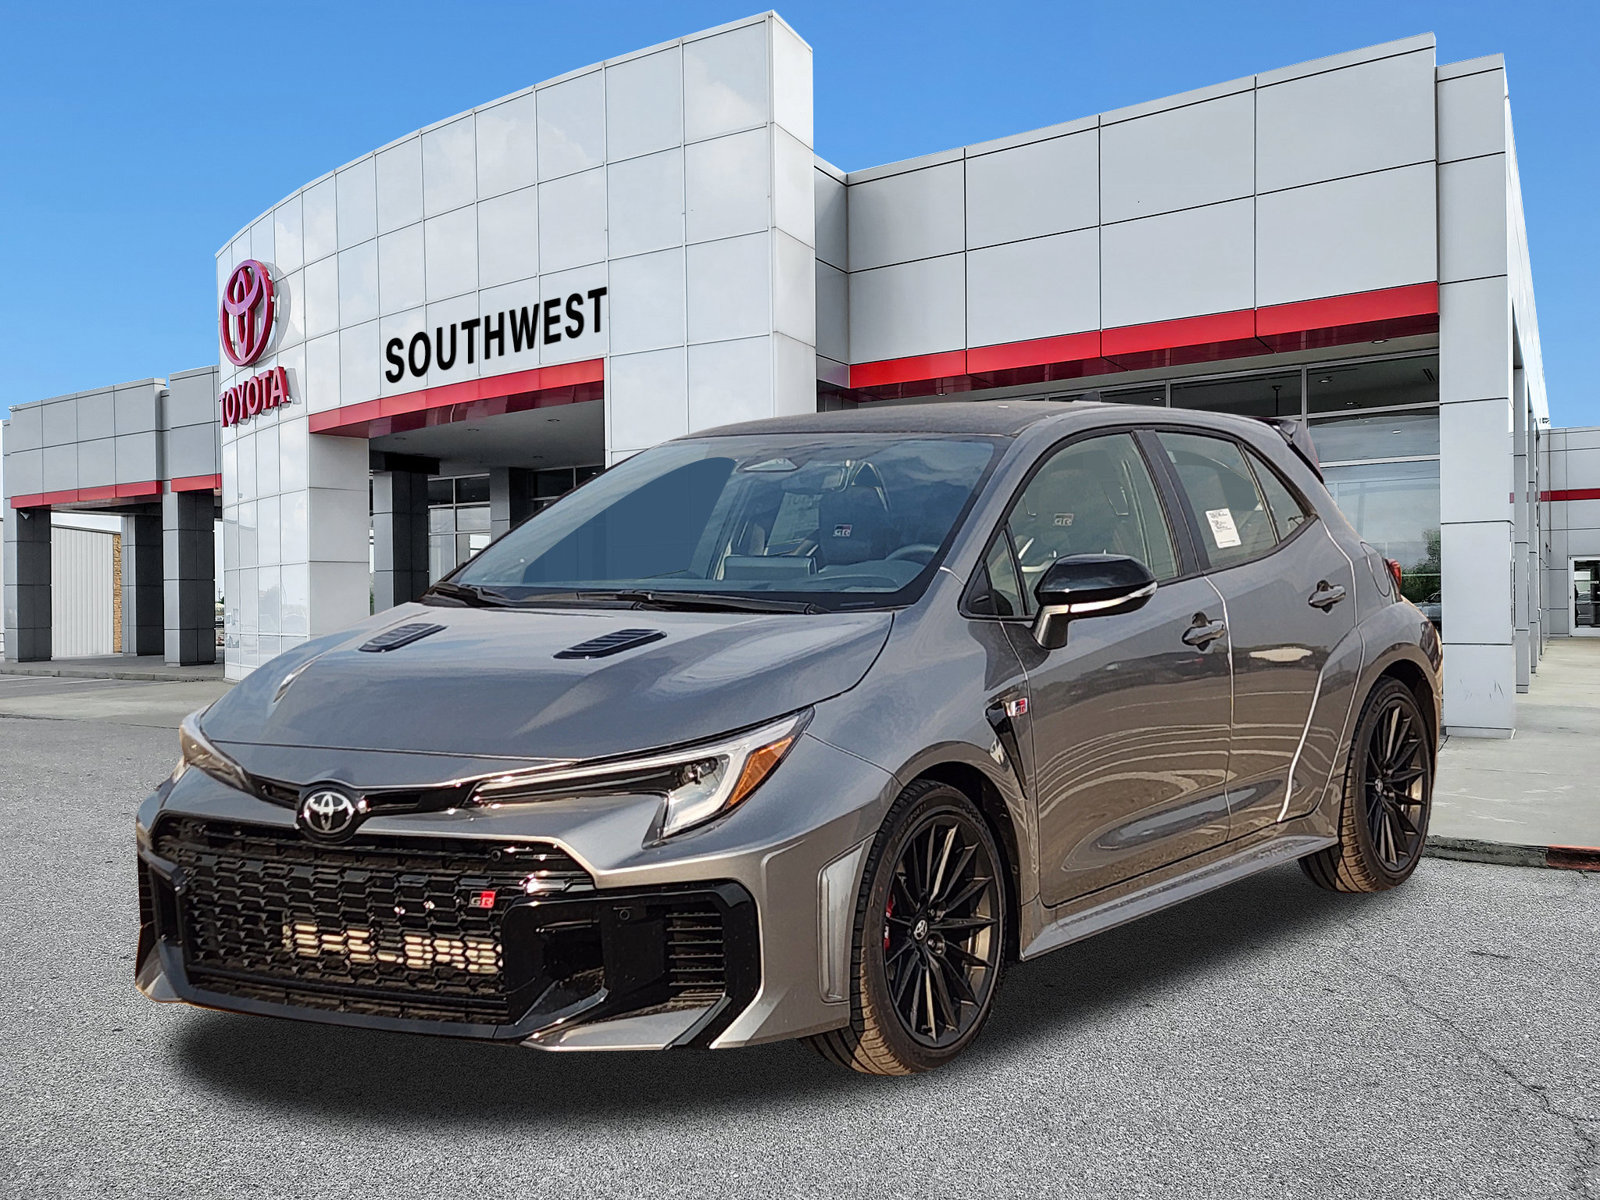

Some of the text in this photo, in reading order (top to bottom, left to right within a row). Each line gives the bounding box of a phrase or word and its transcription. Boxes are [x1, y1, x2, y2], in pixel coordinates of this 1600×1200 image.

[385, 286, 608, 384] SOUTHWEST
[219, 366, 290, 427] TOYOTA
[833, 526, 852, 537] GR
[470, 895, 495, 908] GR
